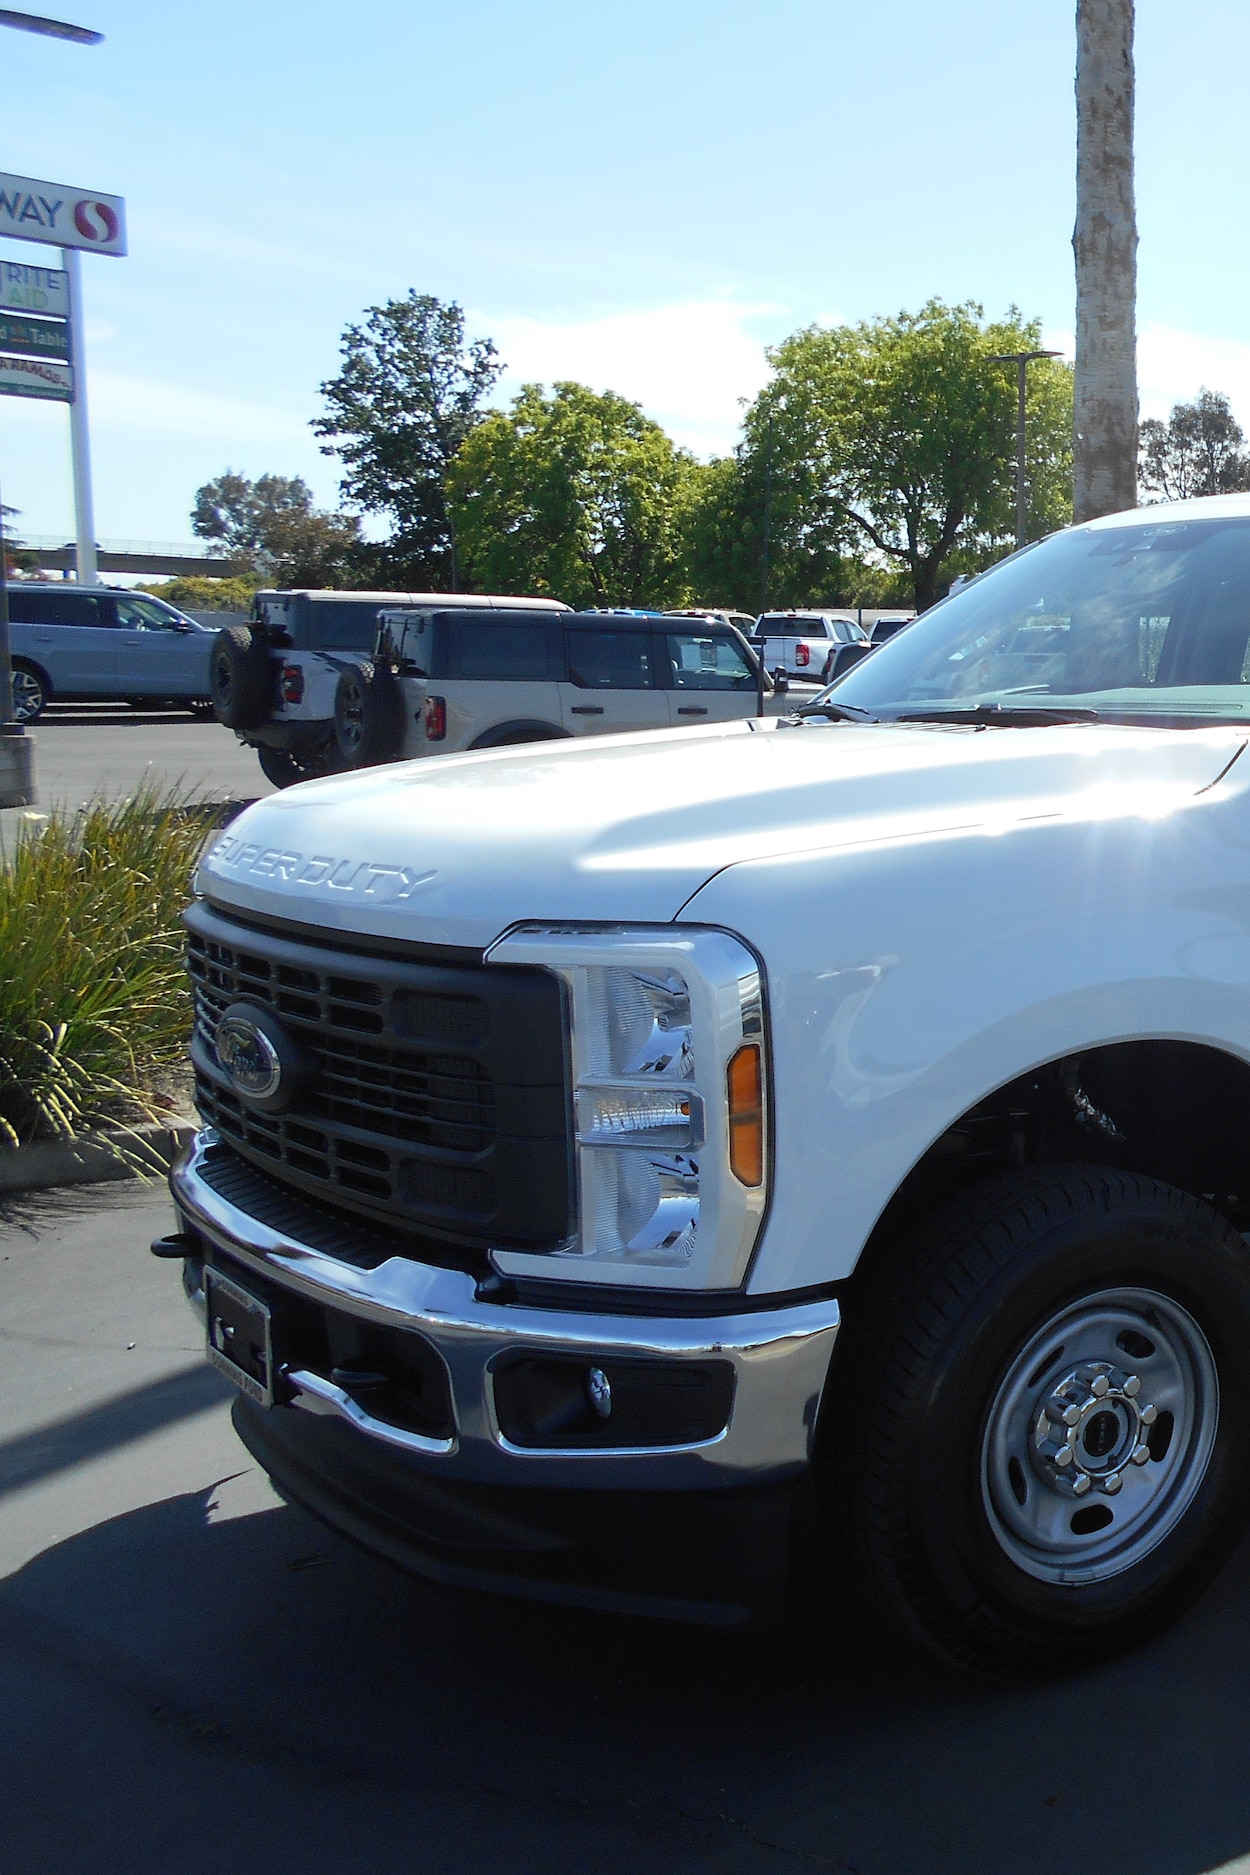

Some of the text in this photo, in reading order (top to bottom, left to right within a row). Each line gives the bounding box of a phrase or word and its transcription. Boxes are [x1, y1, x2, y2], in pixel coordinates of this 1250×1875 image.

[8, 263, 61, 290] RITE
[30, 327, 68, 348] Table
[208, 836, 440, 898] SUPER DUTY
